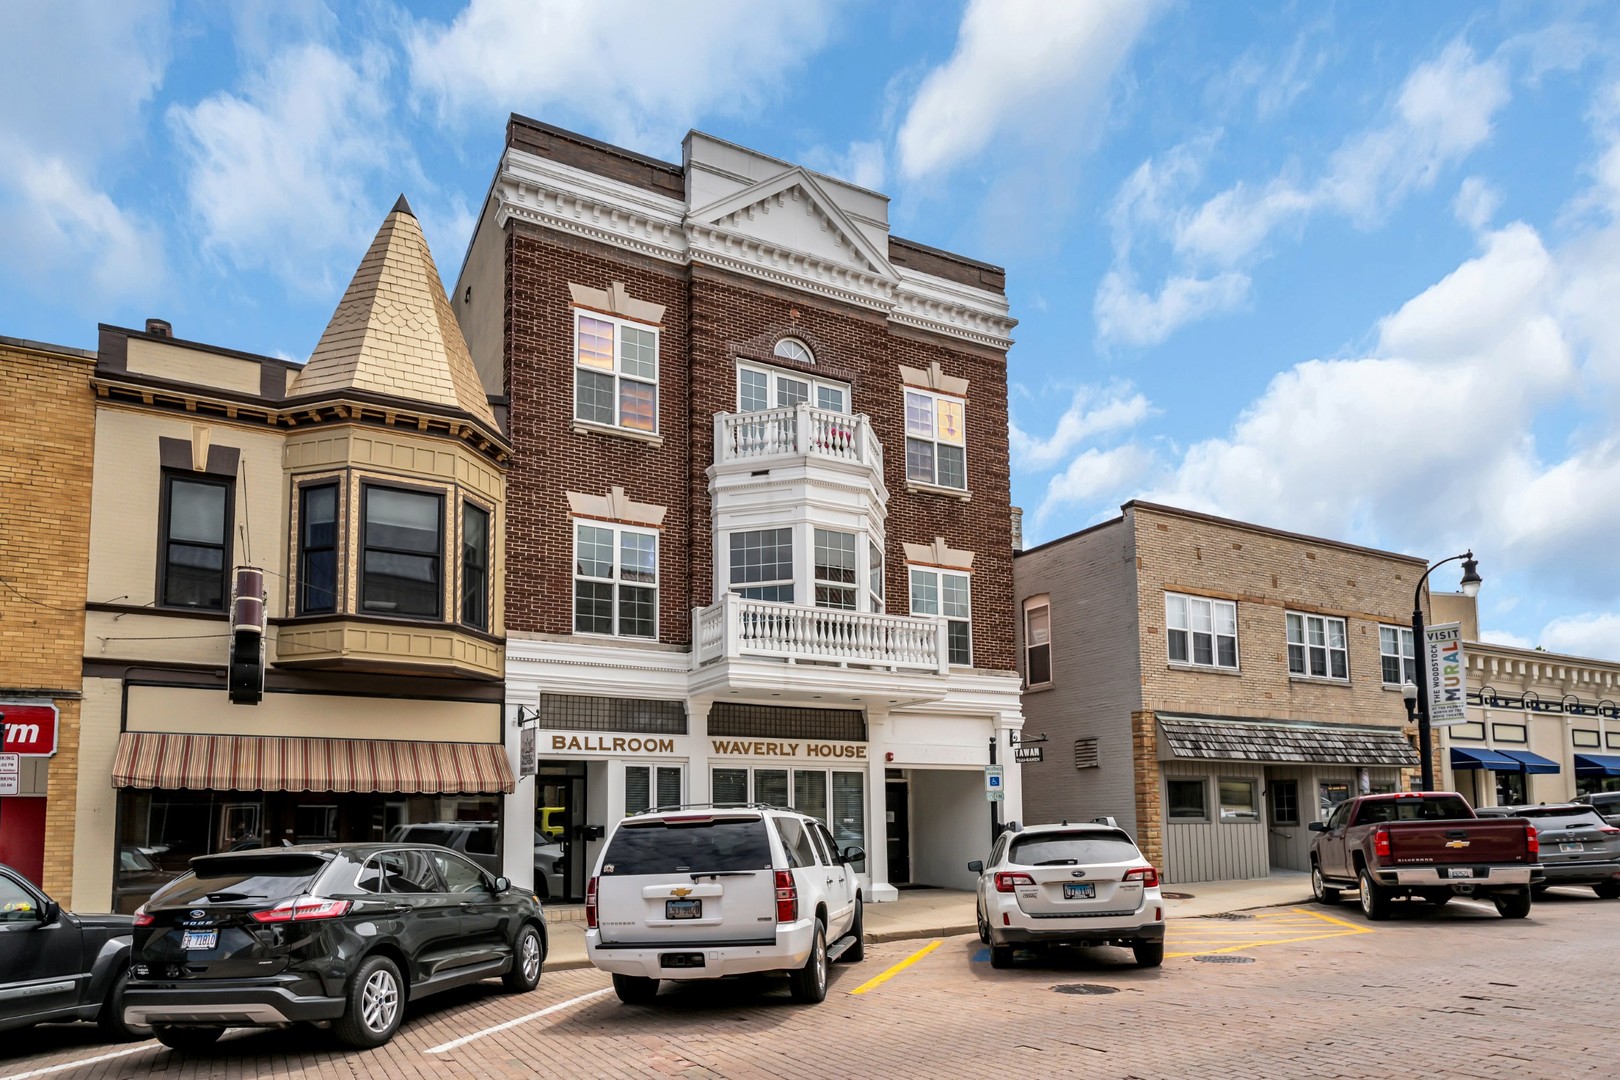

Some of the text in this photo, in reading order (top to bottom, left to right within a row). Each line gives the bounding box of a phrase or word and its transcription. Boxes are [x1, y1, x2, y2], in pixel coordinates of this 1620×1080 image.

[1427, 630, 1459, 641] VISIT
[1430, 644, 1440, 688] WOODSTOCK
[1442, 641, 1461, 702] MURAL
[552, 735, 674, 753] BALLROOM
[712, 740, 867, 759] WAVERLY HOUSE
[1014, 747, 1040, 757] TAWAN
